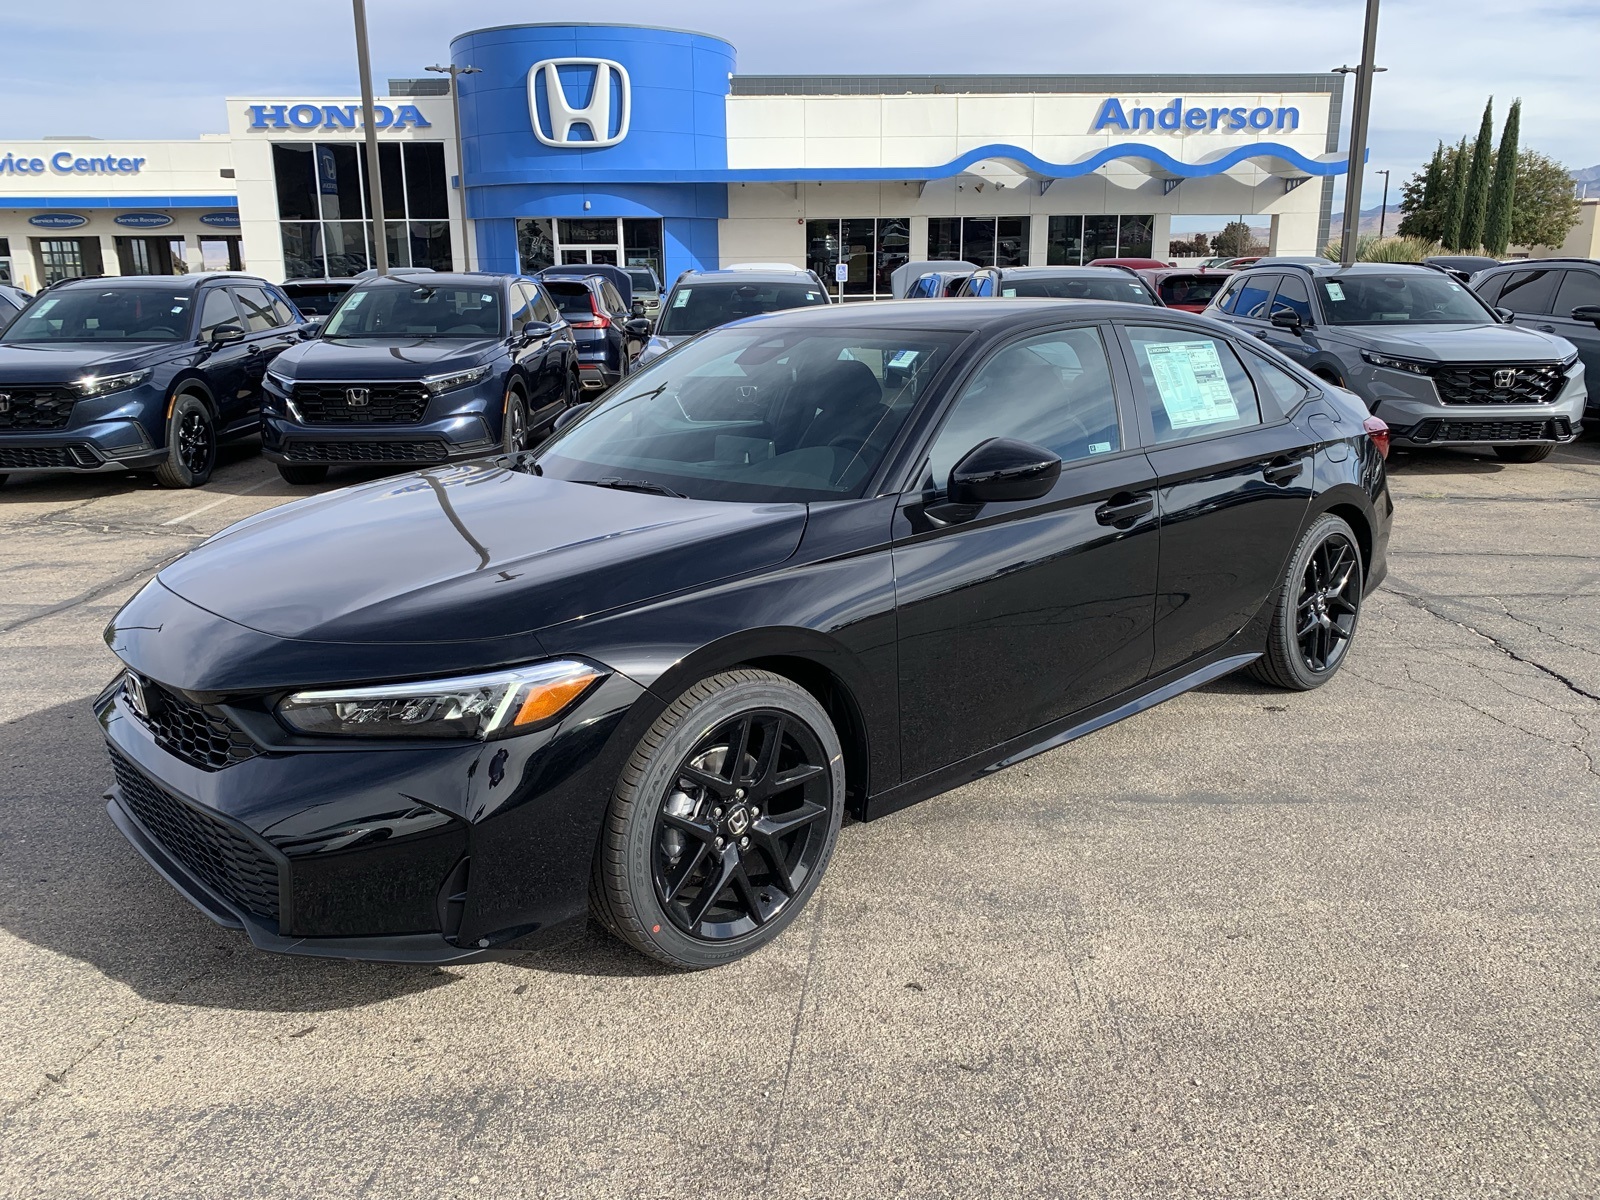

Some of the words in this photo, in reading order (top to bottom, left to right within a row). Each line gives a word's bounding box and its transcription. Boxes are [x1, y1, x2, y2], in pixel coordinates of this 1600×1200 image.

[249, 104, 432, 128] HONDA
[1095, 98, 1300, 130] Anderson
[52, 152, 146, 173] Center
[31, 216, 54, 224] Service
[54, 217, 84, 225] Reception
[117, 216, 139, 224] Service
[139, 217, 169, 225] Reception
